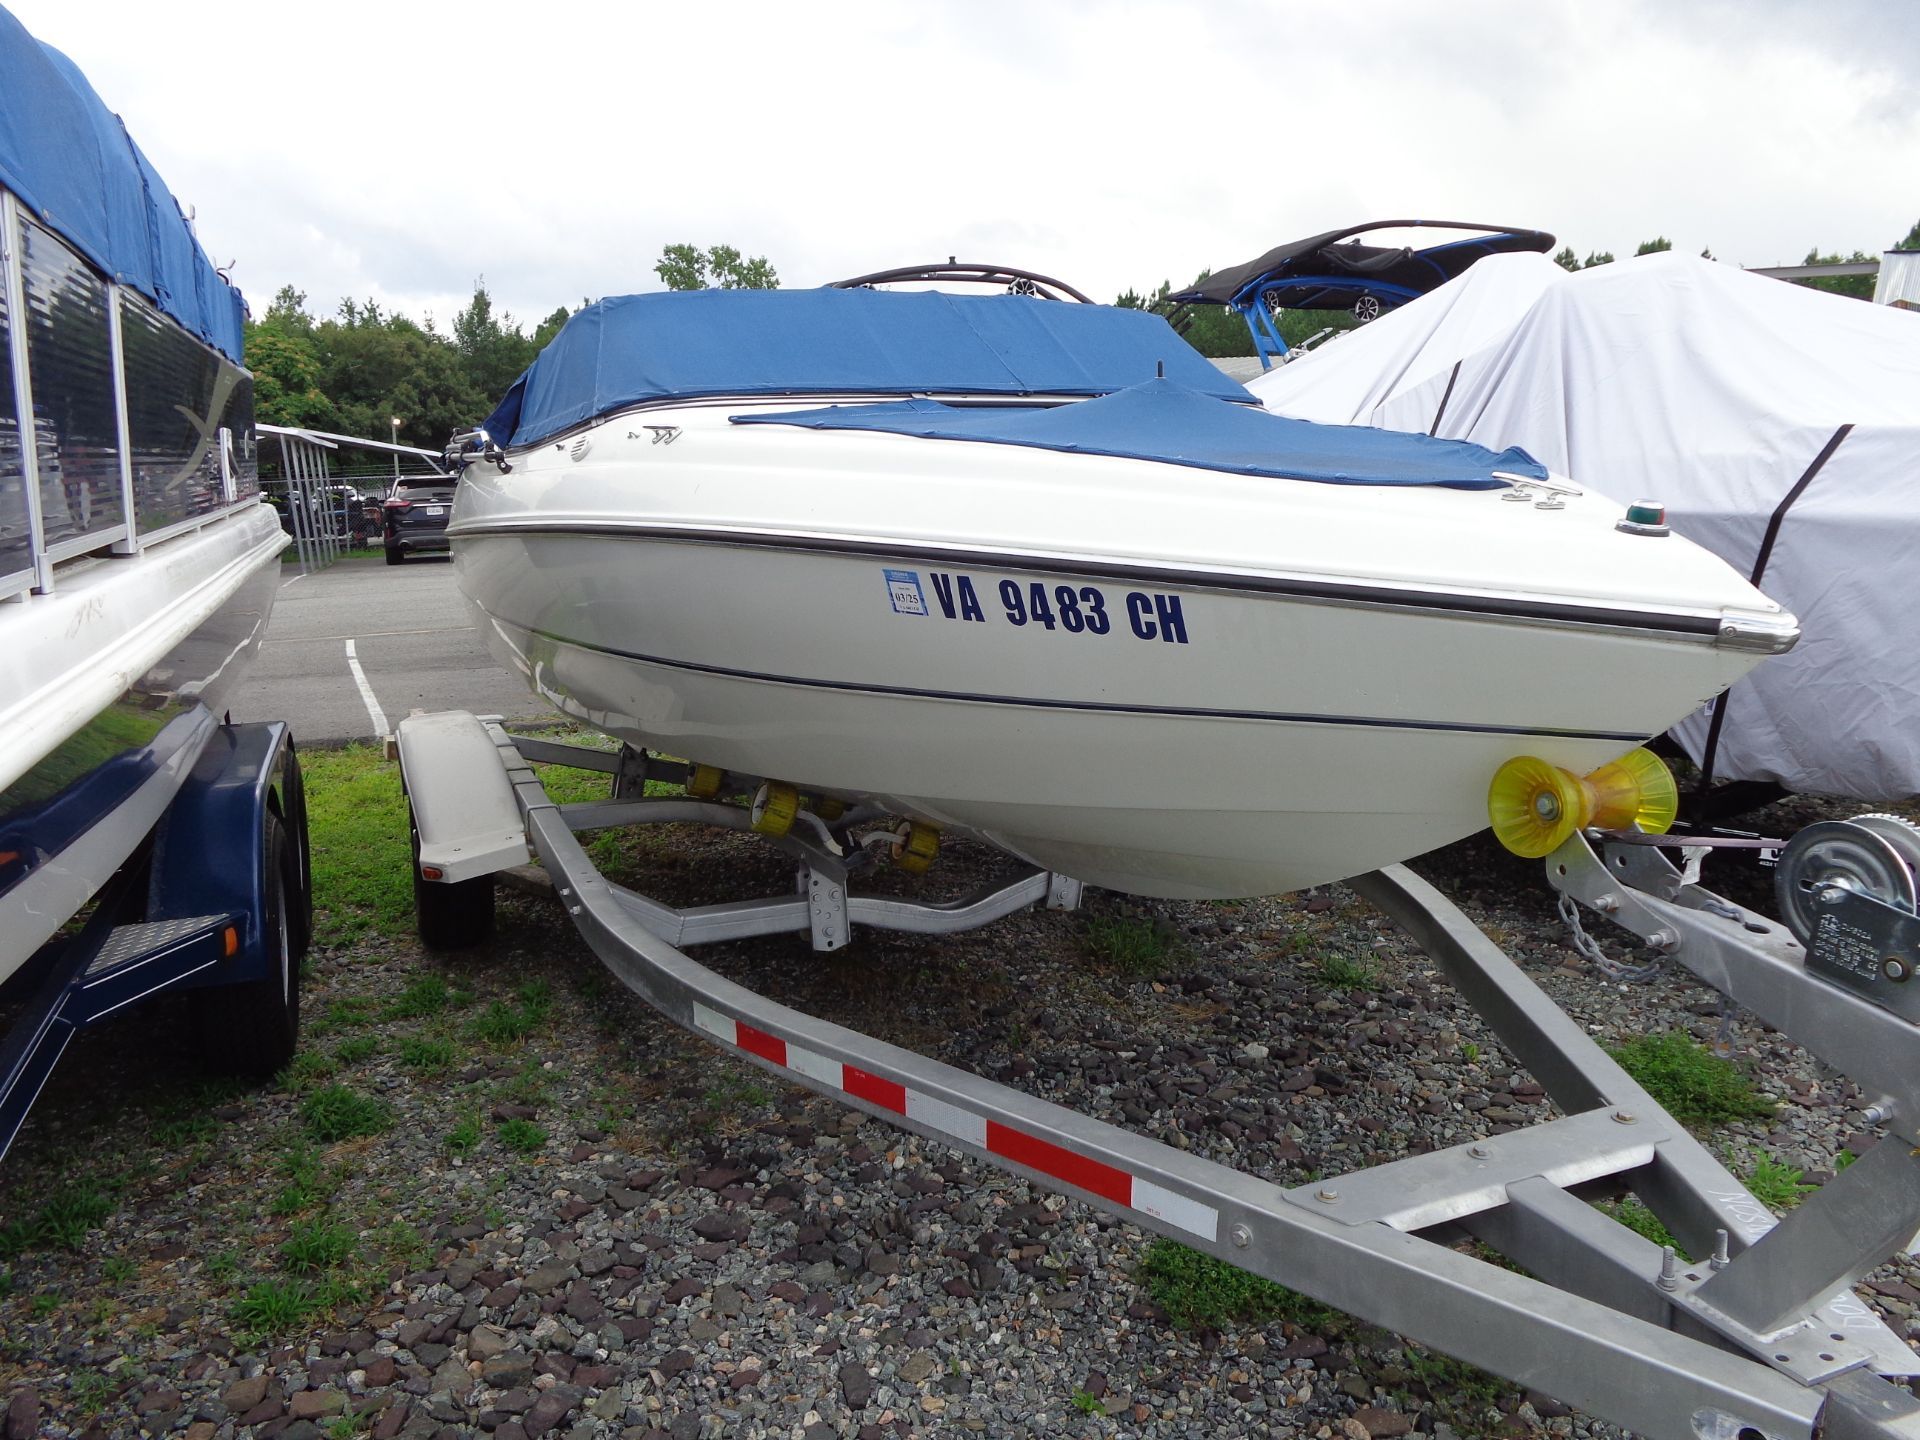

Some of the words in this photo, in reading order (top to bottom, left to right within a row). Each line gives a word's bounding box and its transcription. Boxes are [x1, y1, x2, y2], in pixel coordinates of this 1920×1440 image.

[895, 593, 919, 604] 03/25
[930, 573, 985, 622] VA
[998, 579, 1111, 635] 9483
[1126, 591, 1189, 644] CH
